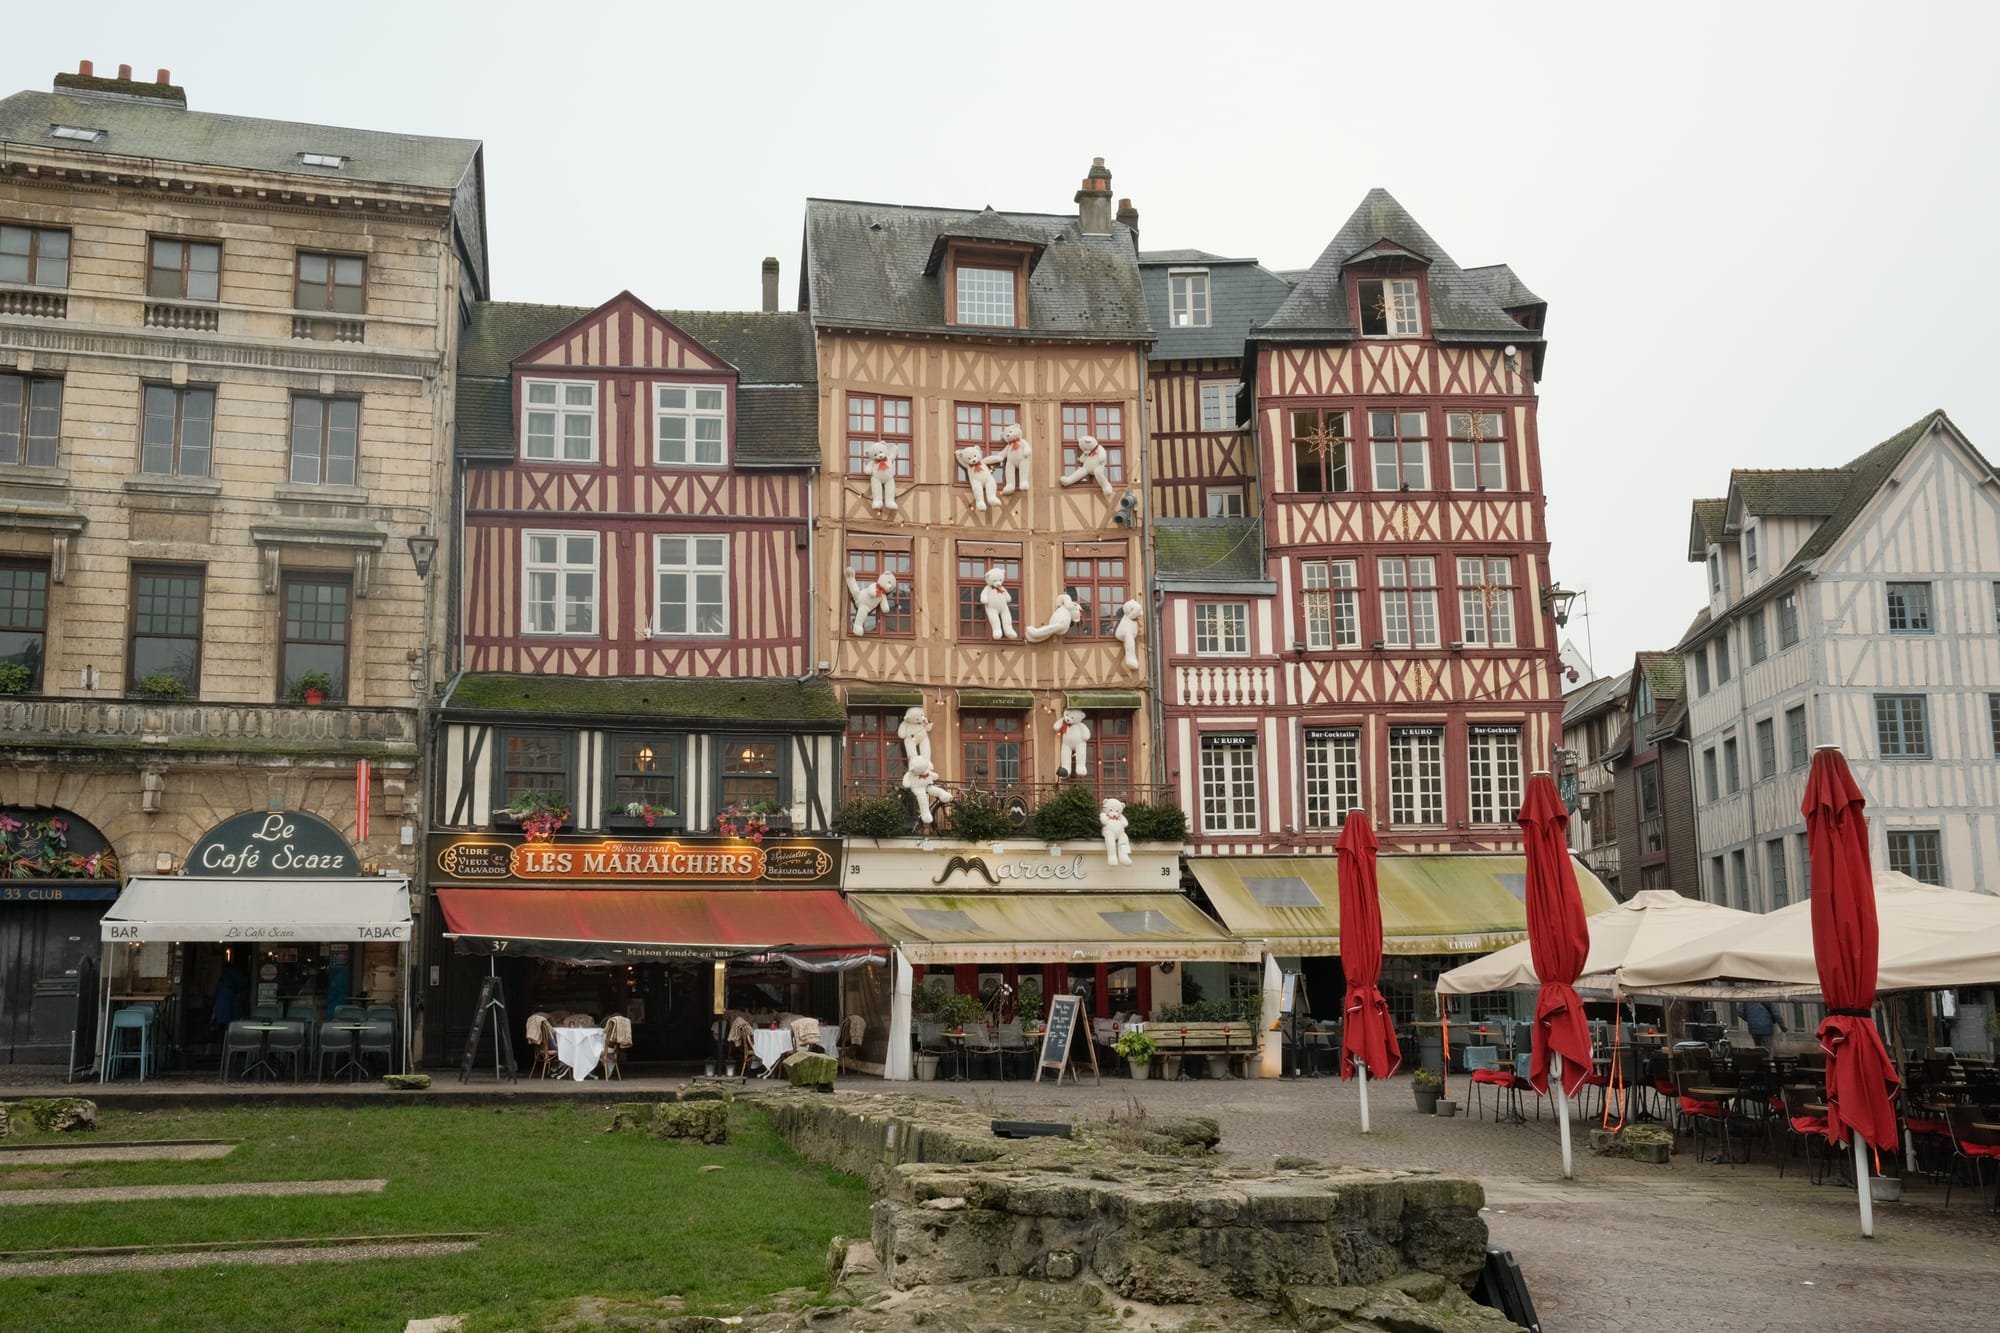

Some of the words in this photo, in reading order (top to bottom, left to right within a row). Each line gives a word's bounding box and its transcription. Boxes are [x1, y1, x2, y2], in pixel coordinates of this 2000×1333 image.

[252, 814, 294, 841] Le
[612, 843, 670, 853] Restaurant
[203, 844, 260, 874] Café
[271, 844, 344, 869] Scazz
[526, 851, 573, 873] LES
[584, 853, 754, 875] MARAICHERS
[850, 864, 861, 874] 39
[1161, 867, 1171, 876] 39
[4, 889, 21, 900] 33
[28, 889, 63, 901] CLUB
[111, 926, 139, 938] BAR
[225, 927, 242, 938] Le
[245, 927, 266, 938] Café
[357, 926, 403, 938] TABAC
[492, 941, 508, 952] 37
[627, 948, 661, 957] Maison
